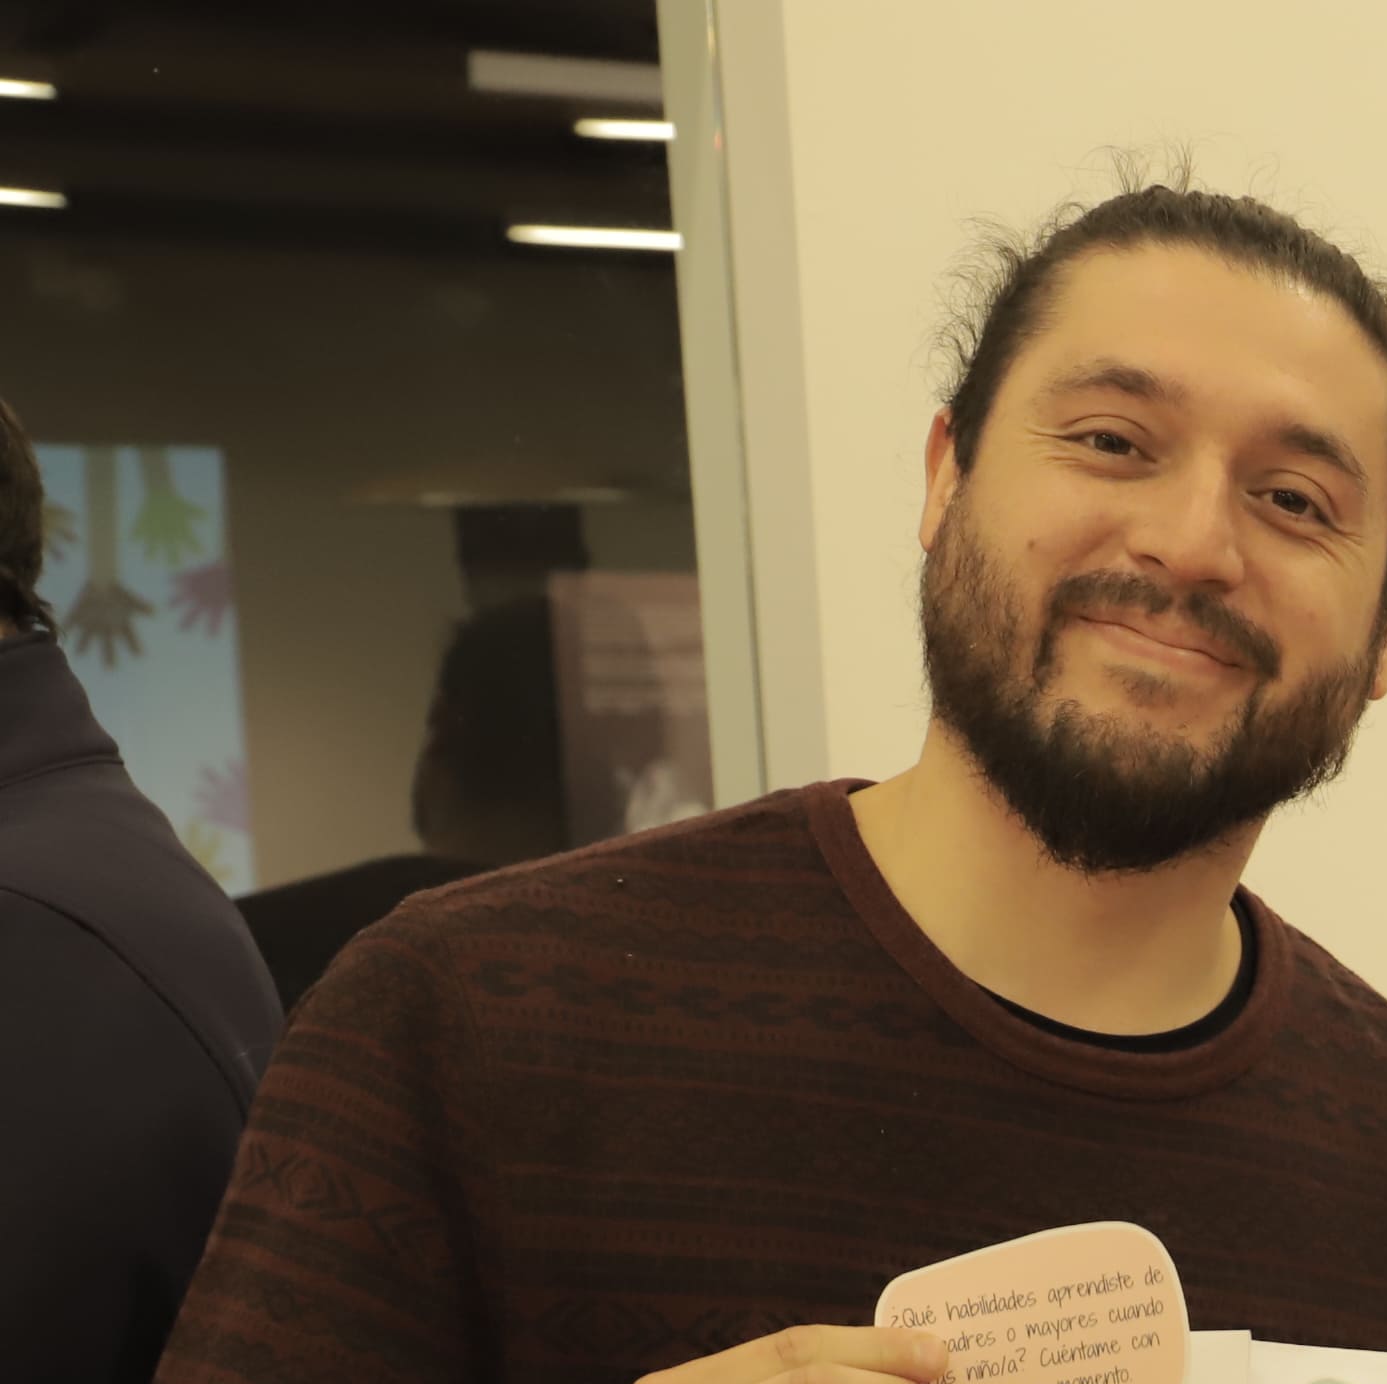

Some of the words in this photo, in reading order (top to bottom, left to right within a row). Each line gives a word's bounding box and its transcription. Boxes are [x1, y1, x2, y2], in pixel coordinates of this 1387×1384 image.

[946, 1289, 1037, 1320] habilidades
[1047, 1271, 1134, 1307] aprendiste
[1144, 1265, 1164, 1285] de
[942, 1330, 995, 1353] adres
[1006, 1328, 1016, 1342] o
[1025, 1312, 1098, 1341] mayores
[1108, 1299, 1164, 1323] cuando
[1039, 1339, 1121, 1367] Cuéntame
[1131, 1331, 1160, 1350] con
